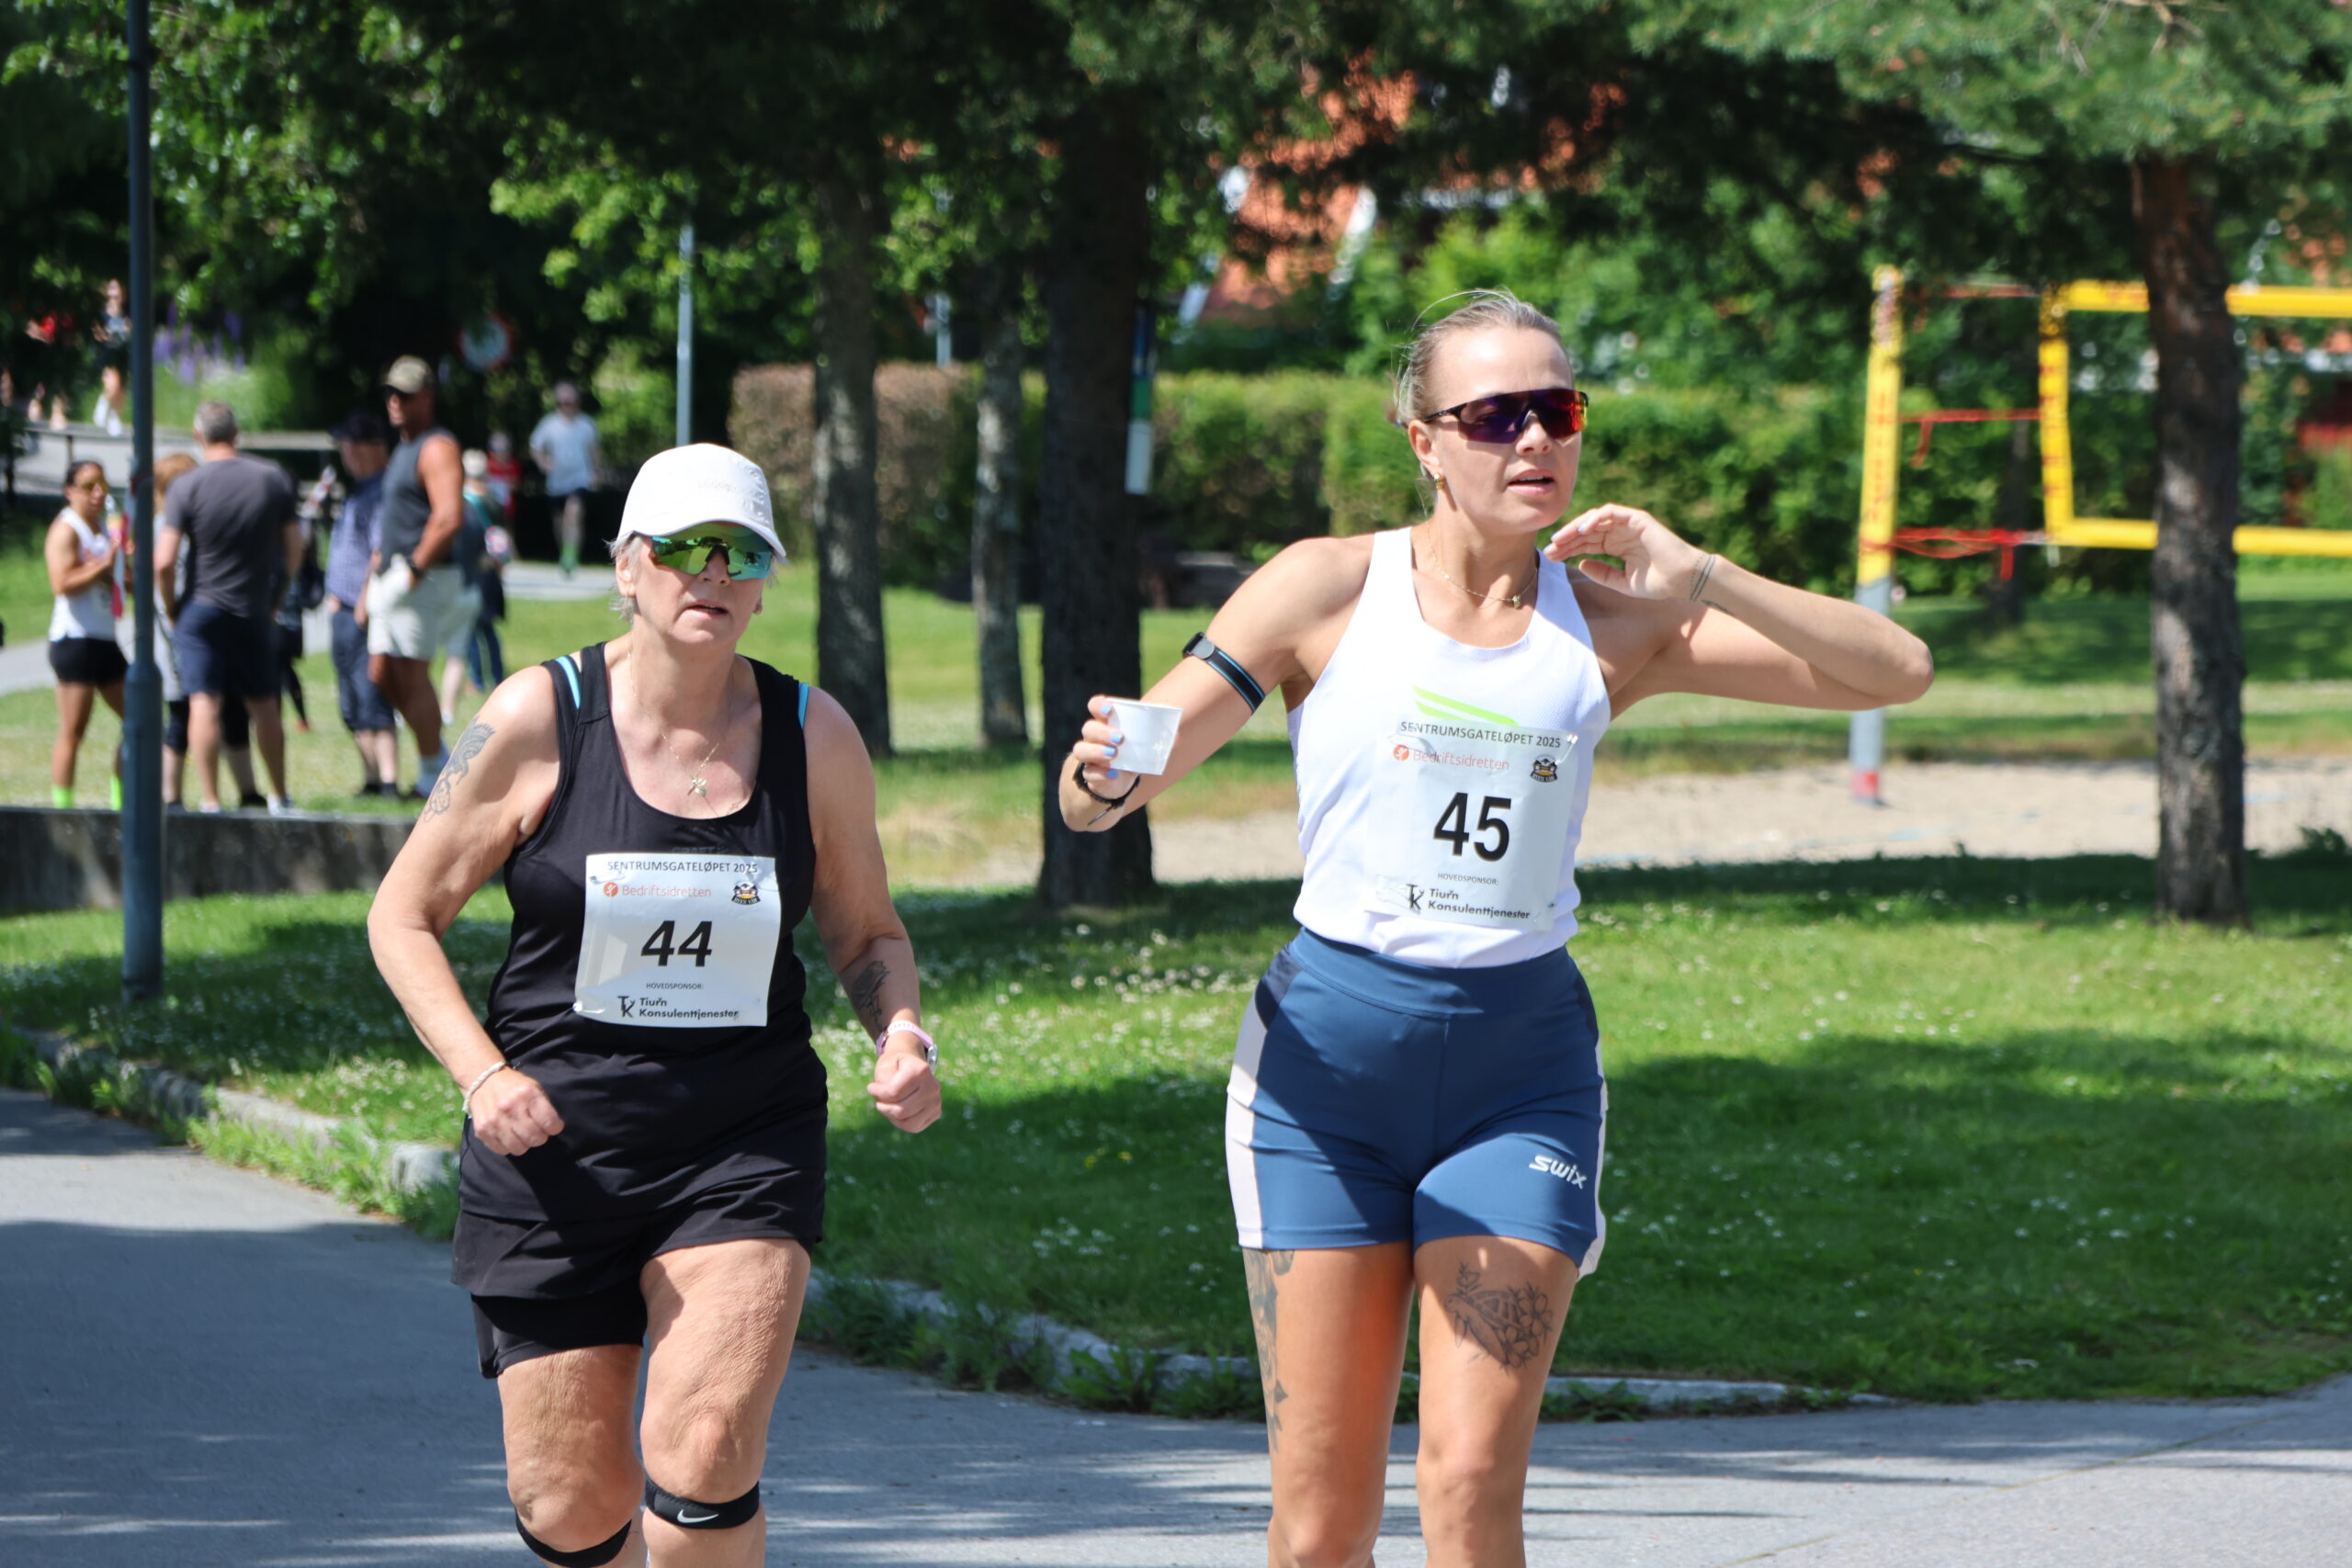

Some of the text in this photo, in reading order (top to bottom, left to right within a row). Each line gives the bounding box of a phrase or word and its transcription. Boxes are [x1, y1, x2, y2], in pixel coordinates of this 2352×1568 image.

[1400, 721, 1561, 749] SENTRUMSGATELØPET 2025
[1413, 750, 1510, 772] Bedriftsidretten
[1432, 792, 1512, 863] 45
[607, 861, 758, 874] SENTRUMSGATELØPET 2025
[1437, 873, 1499, 886] HOVEDSPONSOR:
[622, 885, 712, 897] Bedriftsidretten
[1428, 900, 1531, 919] Konsulenttjenester
[640, 919, 713, 967] 44
[639, 1009, 740, 1021] Konsulenttjenester
